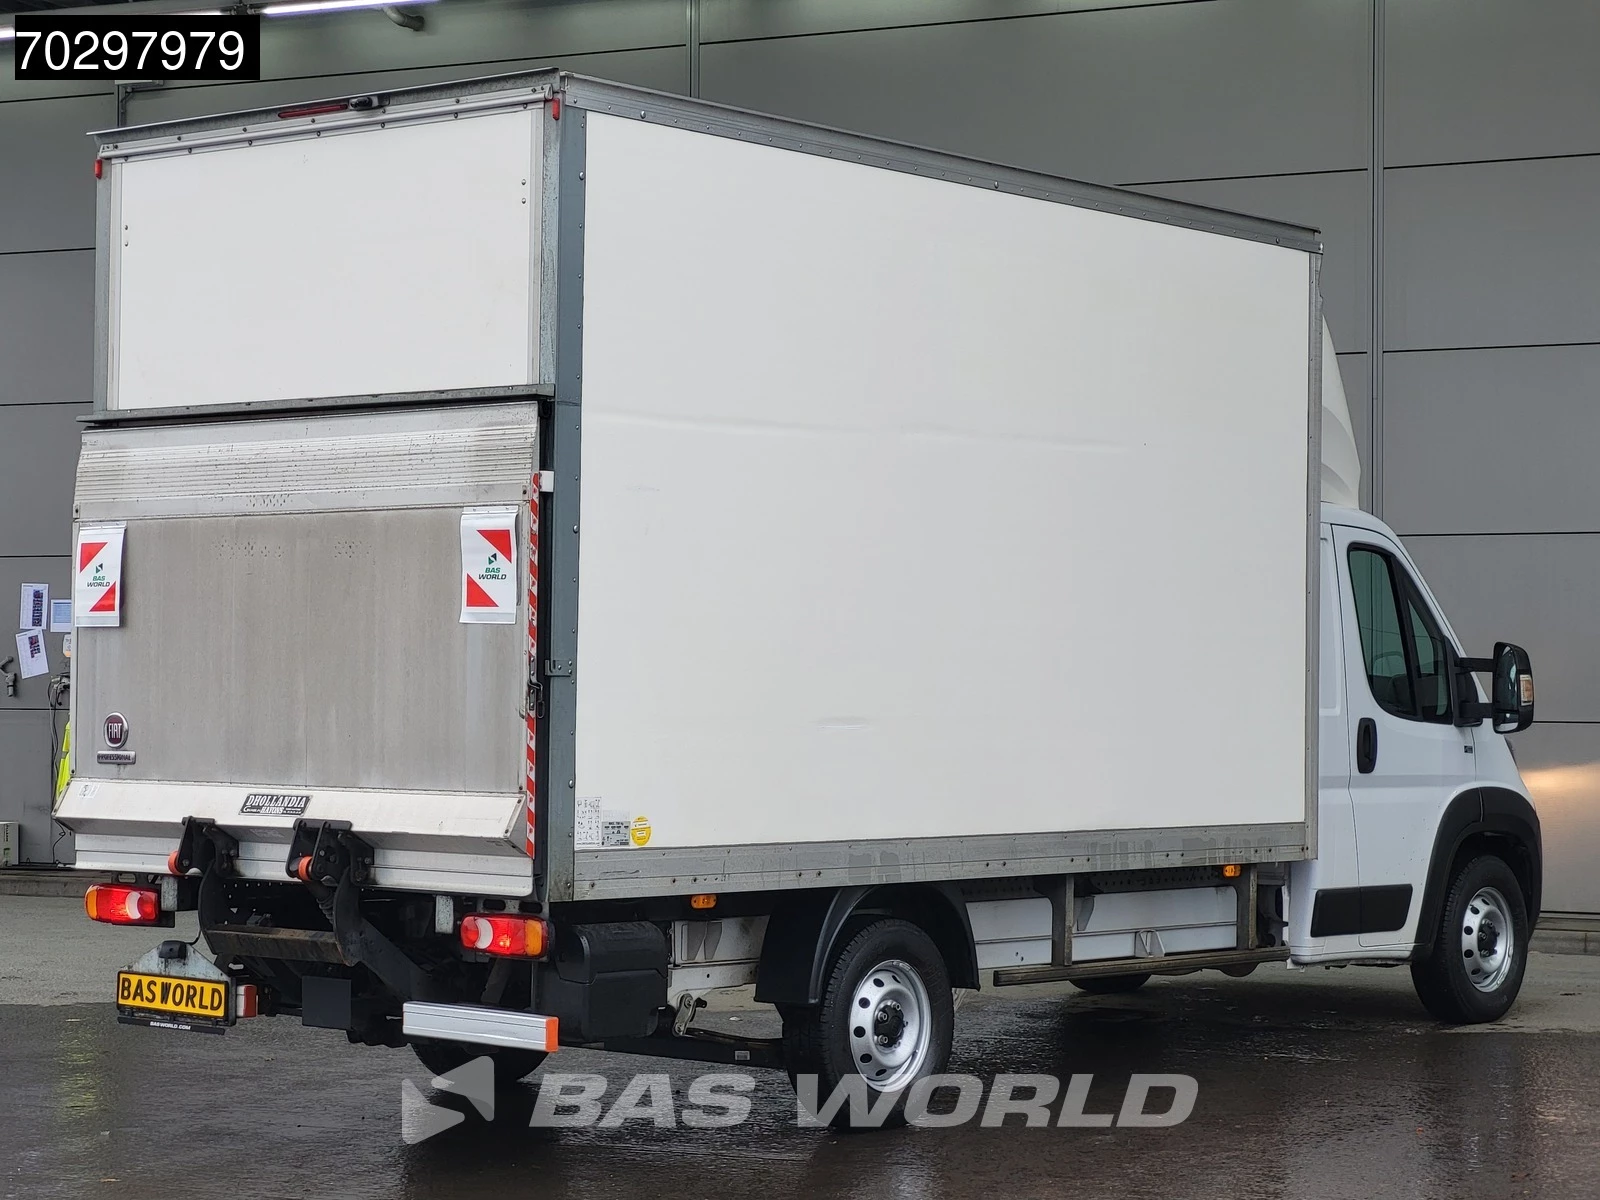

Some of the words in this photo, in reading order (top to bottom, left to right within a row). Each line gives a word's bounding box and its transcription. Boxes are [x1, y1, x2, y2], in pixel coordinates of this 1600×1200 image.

[108, 723, 122, 739] FIAT
[98, 753, 131, 761] PROFESSIONAL
[246, 794, 307, 808] DHOLLANDIA
[120, 977, 157, 1003] BAS
[160, 981, 222, 1011] WORLD
